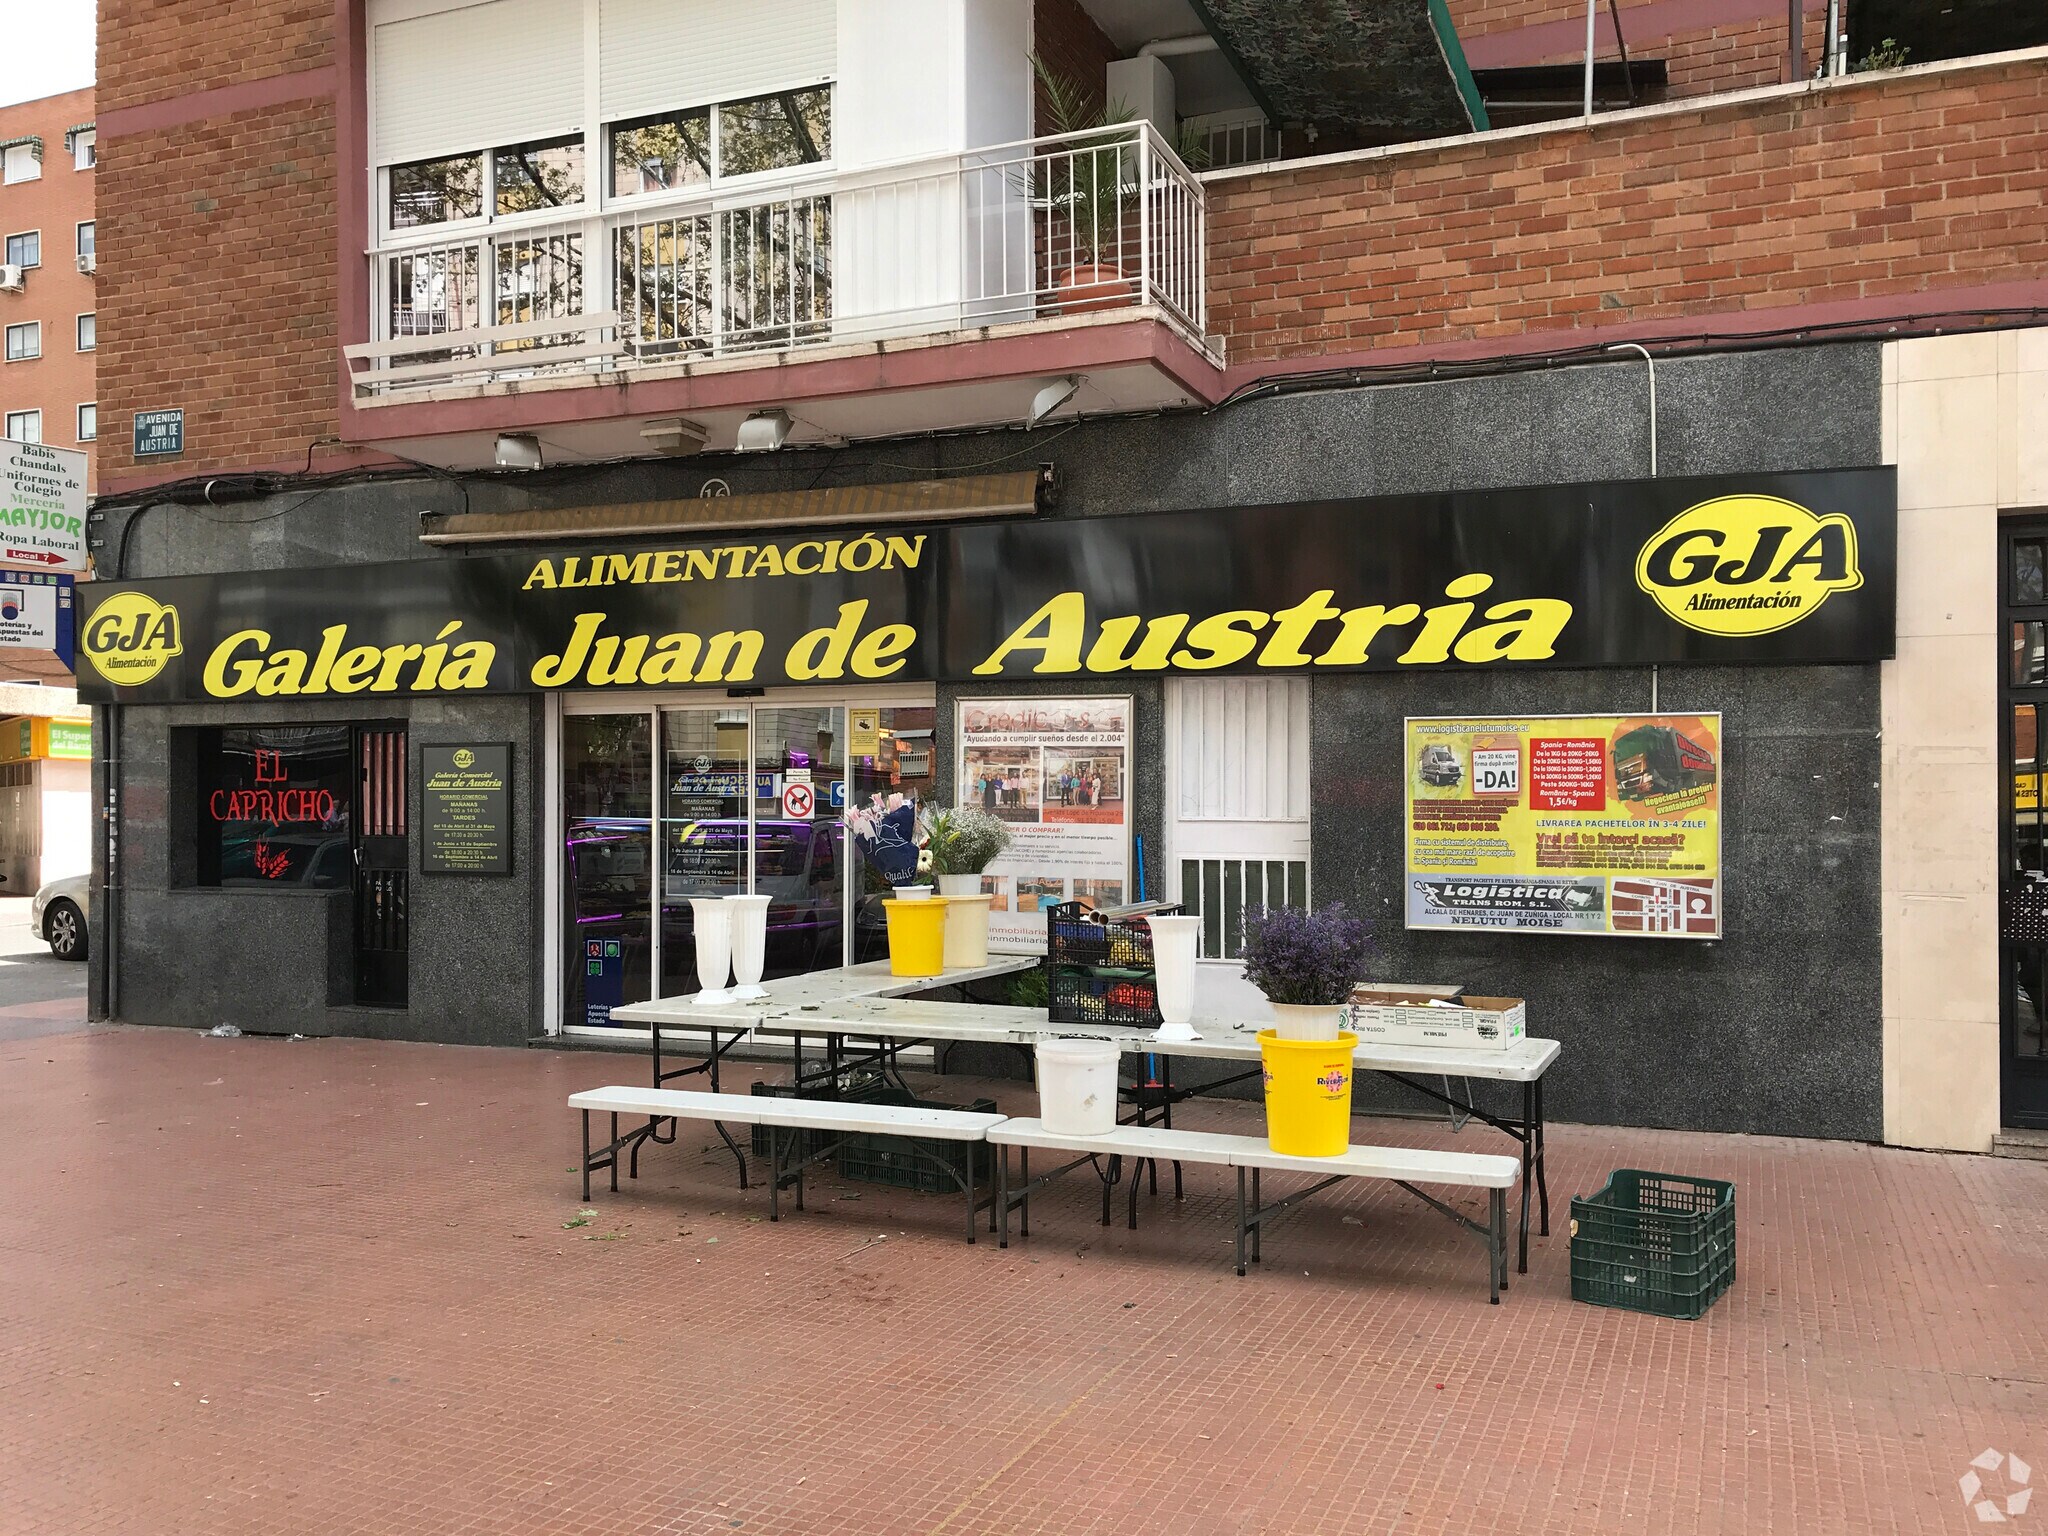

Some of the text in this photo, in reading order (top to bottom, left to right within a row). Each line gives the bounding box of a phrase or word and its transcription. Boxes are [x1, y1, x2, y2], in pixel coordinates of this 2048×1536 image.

[146, 412, 181, 424] AVENIDA
[149, 423, 178, 437] JUAN DE
[140, 437, 176, 451] AUSTRIA
[22, 445, 56, 459] Babis
[10, 456, 67, 473] Chandals
[14, 481, 62, 497] Colegio
[65, 478, 79, 489] de
[10, 493, 65, 510] Mercería
[0, 508, 82, 538] MAYJOR
[32, 536, 79, 551] Laboral
[13, 550, 38, 560] Local
[522, 532, 927, 590] ALIMENTACIÓN
[1647, 524, 1849, 587] GJA
[1684, 590, 1801, 611] Alimentación
[86, 611, 177, 653] GJA
[202, 573, 1574, 698] Galería Juan de Austria
[105, 655, 157, 670] Alimentación
[52, 730, 61, 739] El
[1416, 722, 1529, 735] www.logisticanelutumoise.eu
[1010, 735, 1036, 743] cumplir
[1038, 734, 1064, 742] sueños
[1066, 734, 1089, 742] desde
[1091, 734, 1098, 742] el
[1540, 741, 1562, 749] Spania
[454, 753, 474, 762] GJA
[255, 749, 288, 783] EL
[427, 778, 502, 788] Juan de Austria
[1476, 771, 1516, 788] -DA!
[671, 783, 691, 792] Juan
[693, 783, 704, 791] de
[1549, 797, 1577, 807] 1,5€/kg
[1644, 792, 1680, 807] Negociem
[1680, 789, 1688, 798] la
[210, 789, 334, 827] CAPRICHO
[1536, 819, 1582, 827] LIVRAREA
[1648, 817, 1659, 827] ÎN
[1663, 820, 1678, 828] 3-4
[1414, 838, 1431, 846] Firma
[1441, 838, 1466, 846] sistemul
[1467, 838, 1475, 846] de
[1536, 832, 1561, 844] Vrei
[1582, 834, 1595, 844] te
[1443, 884, 1564, 900] Logistica
[1424, 907, 1448, 915] ALCALÁ
[1458, 909, 1489, 917] HENARES,
[1524, 909, 1549, 918] ZUÑIGA
[1451, 916, 1563, 928] NELUTU MOISE
